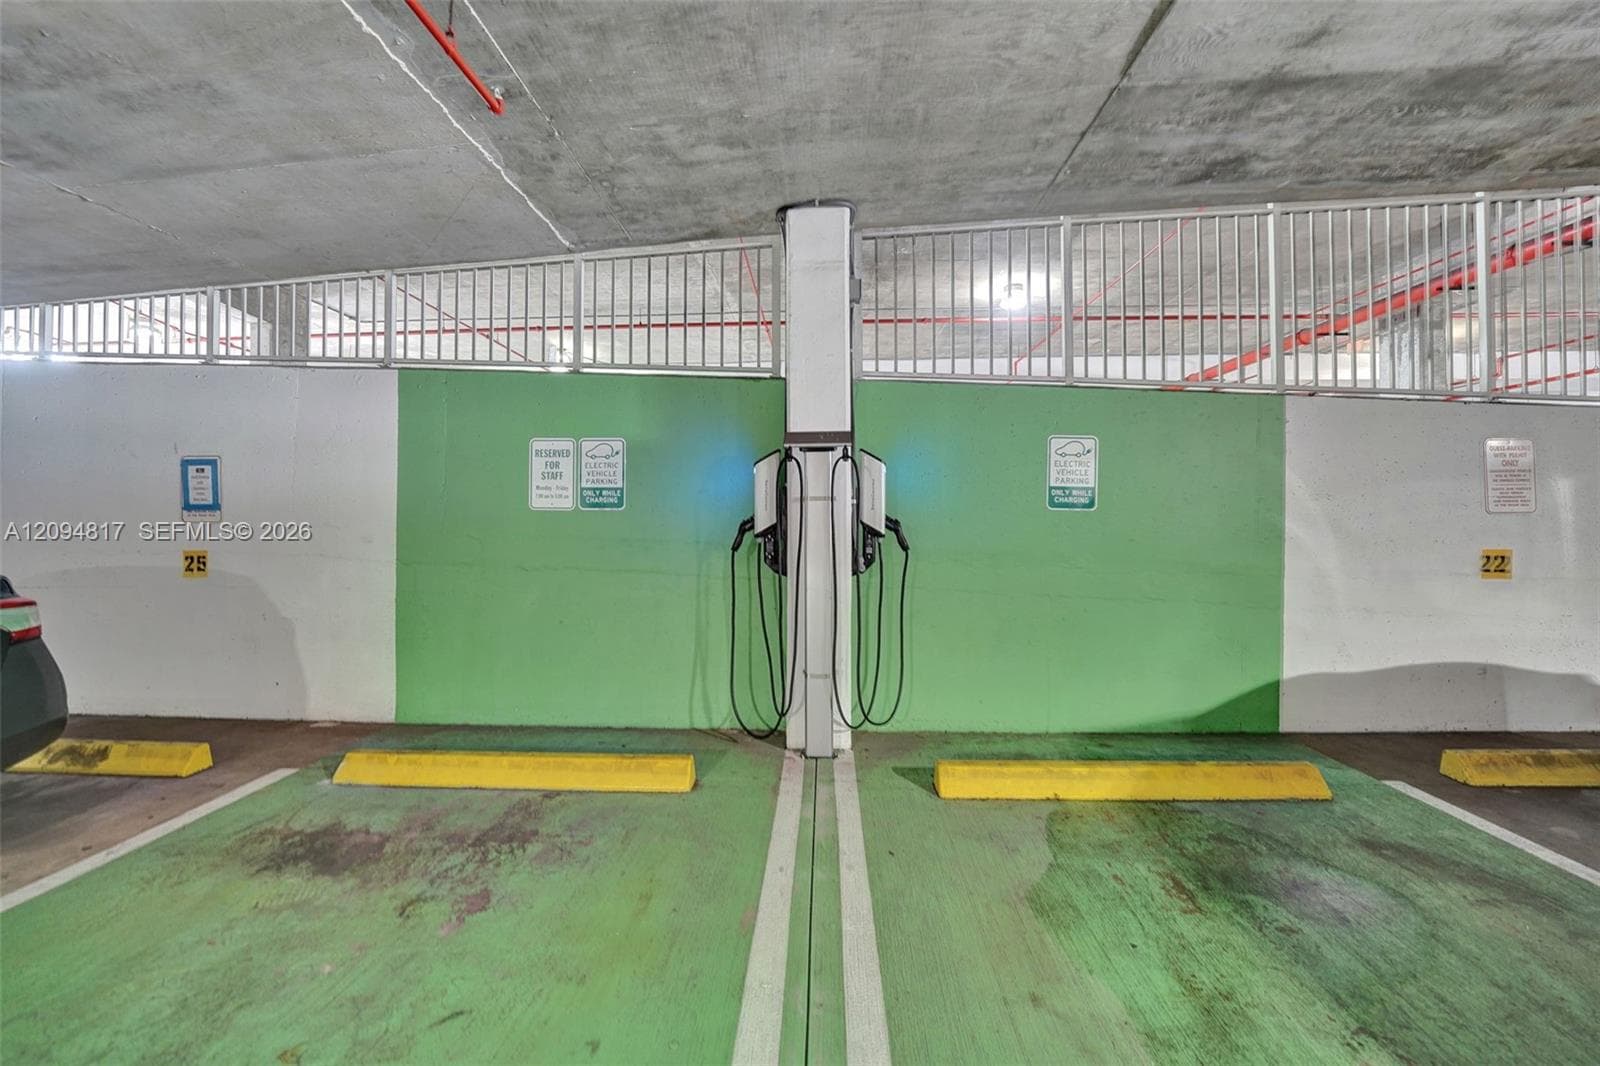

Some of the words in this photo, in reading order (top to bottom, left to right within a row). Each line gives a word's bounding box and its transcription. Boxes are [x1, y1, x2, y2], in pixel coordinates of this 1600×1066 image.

[535, 449, 570, 458] RESERVED
[545, 461, 560, 469] FOR
[541, 472, 563, 480] STAFF
[184, 555, 207, 573] 25
[1481, 555, 1506, 573] 22
